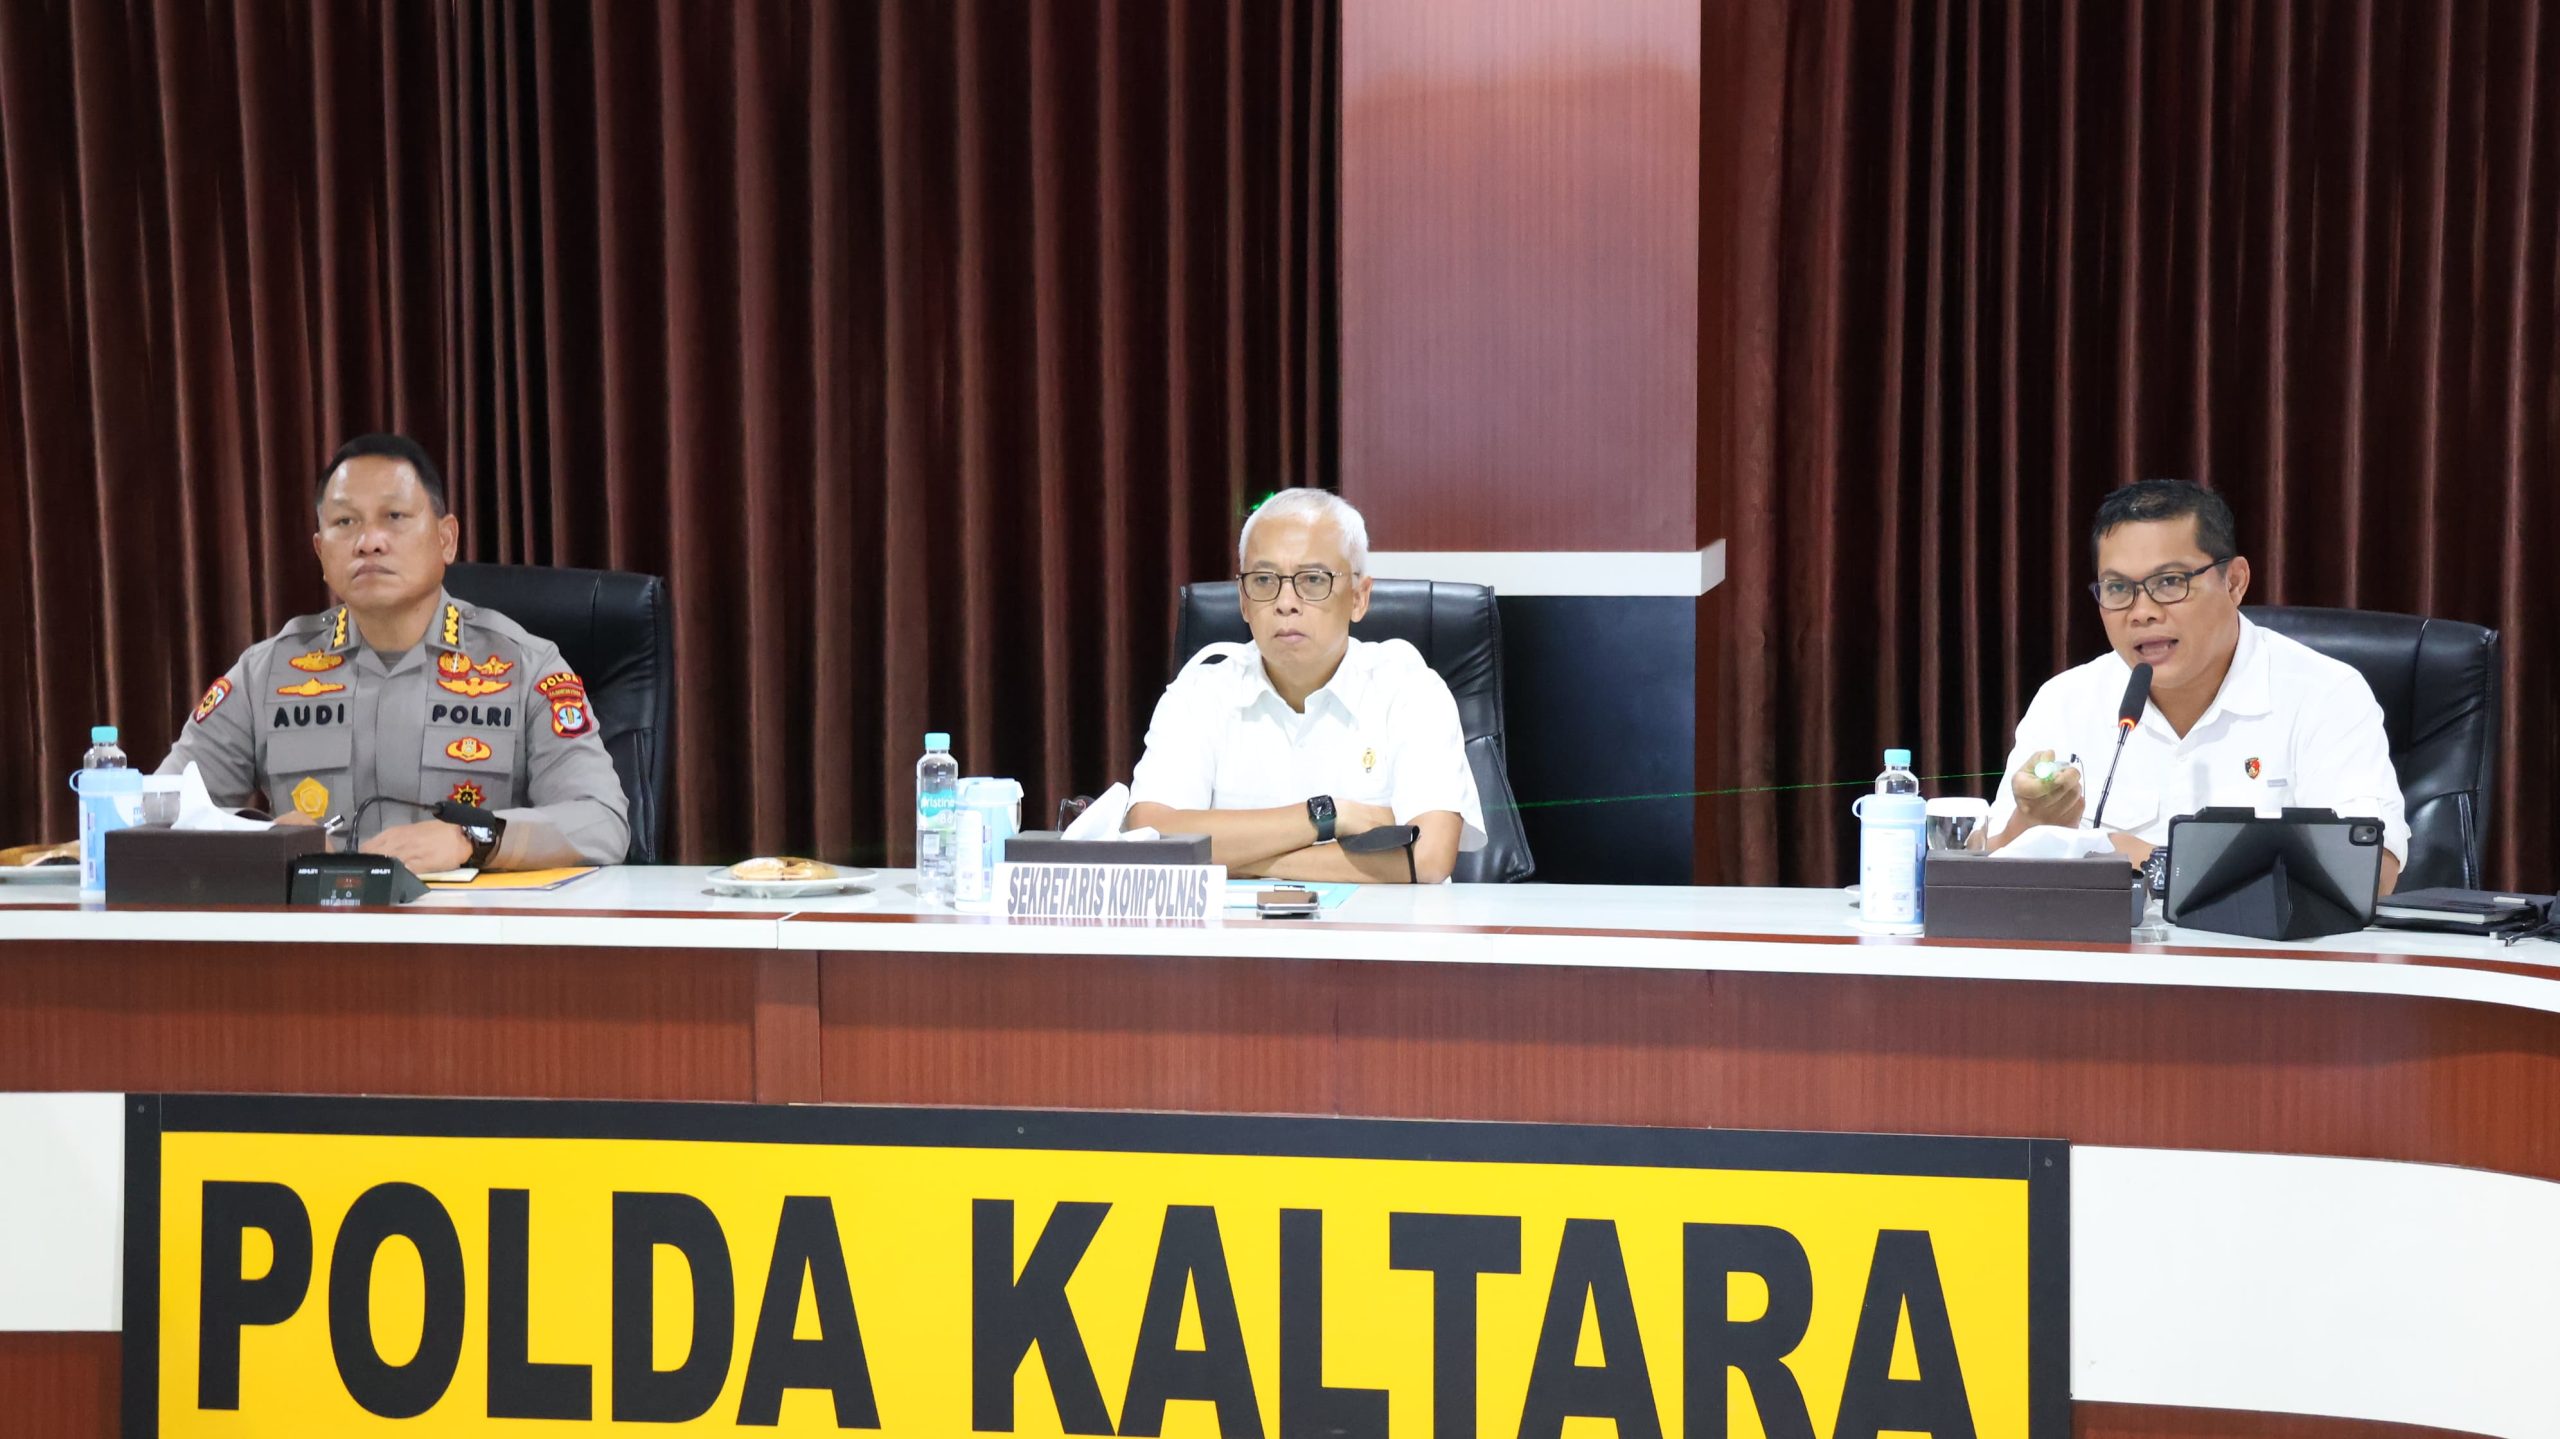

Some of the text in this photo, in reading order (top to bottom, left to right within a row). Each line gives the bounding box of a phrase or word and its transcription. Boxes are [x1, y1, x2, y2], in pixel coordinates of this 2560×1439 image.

[540, 672, 579, 691] POLDA
[273, 703, 345, 728] AUDI
[432, 703, 512, 727] POLRI
[1007, 866, 1209, 918] SEKRETARIS KOMPOLNAS
[197, 1180, 1980, 1439] POLDA KALTARA
